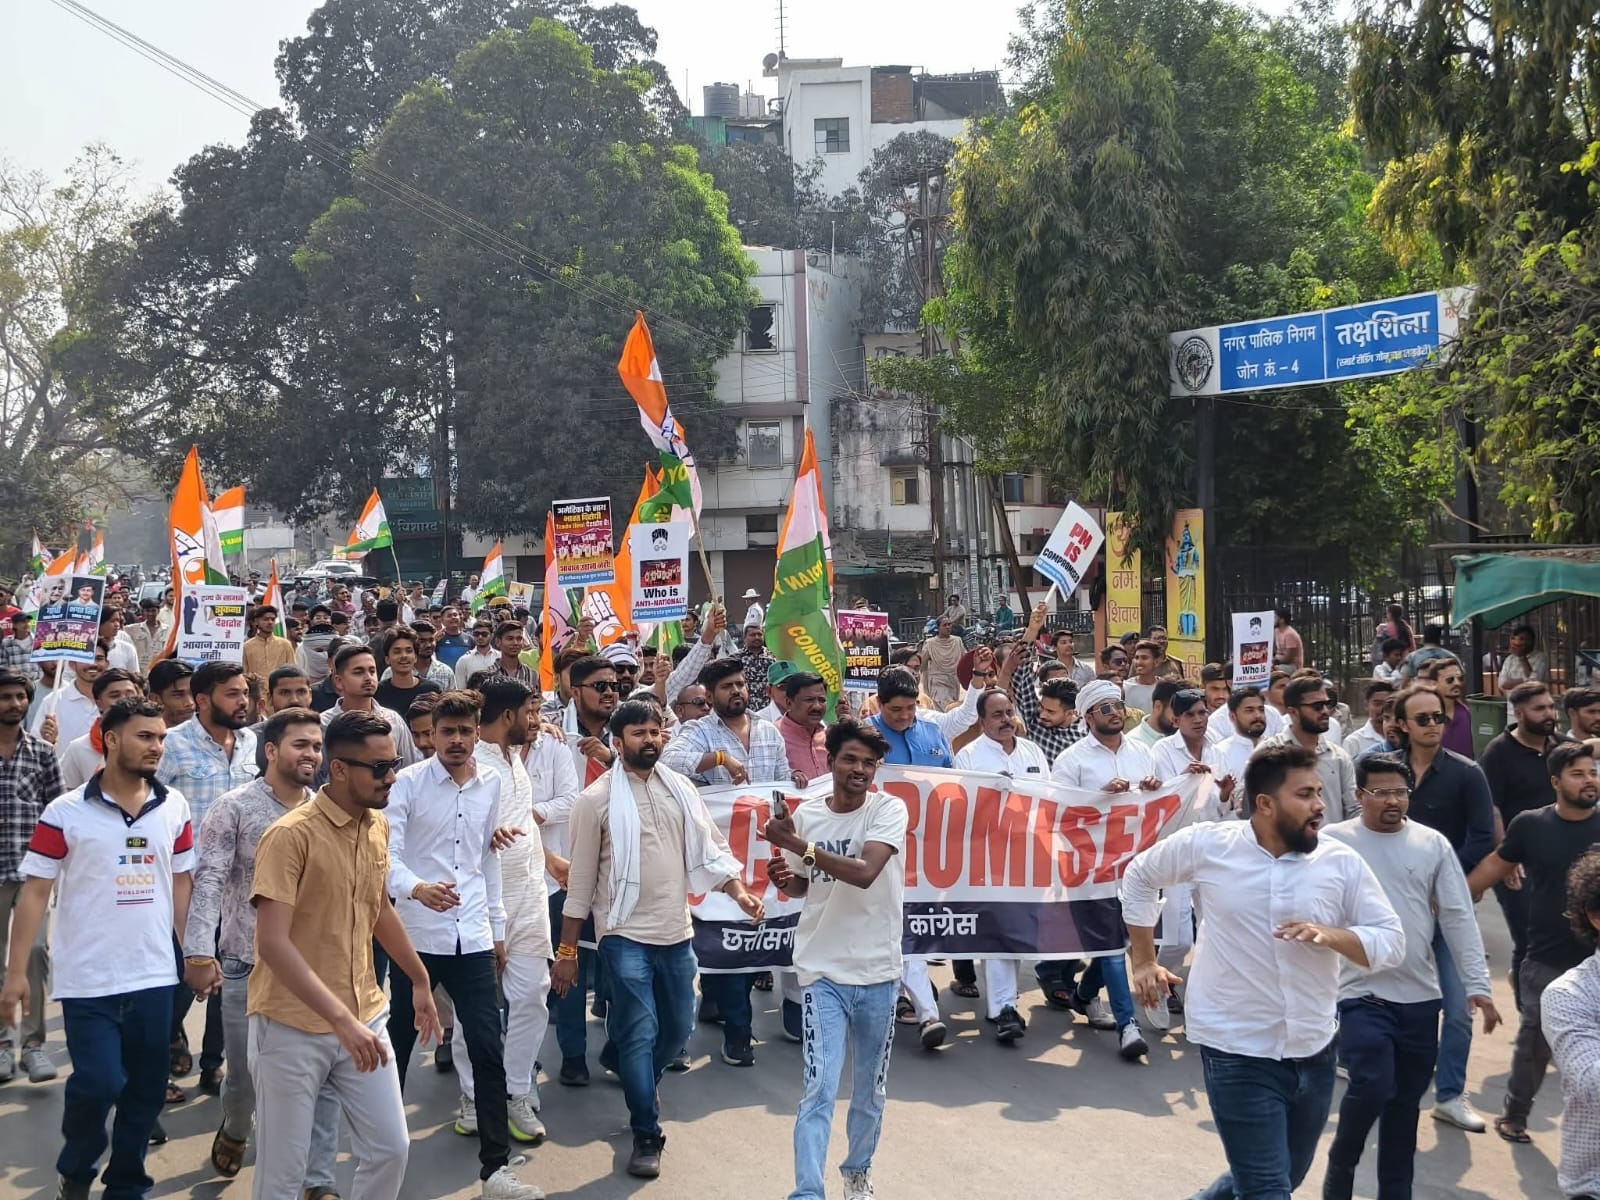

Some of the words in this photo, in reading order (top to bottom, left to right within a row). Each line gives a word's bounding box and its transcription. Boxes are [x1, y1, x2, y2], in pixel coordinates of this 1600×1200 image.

[1223, 336, 1246, 352] नगर
[1248, 328, 1284, 349] पालिक
[1286, 324, 1317, 345] निगम
[1334, 310, 1431, 348] तक्षशिला
[1236, 360, 1259, 379] जोन
[1069, 523, 1093, 550] PM
[1064, 541, 1081, 563] IS
[644, 588, 667, 599] Who
[669, 586, 679, 597] is
[1107, 599, 1140, 624] शिवाय
[183, 641, 213, 650] आवाज
[214, 641, 240, 650] उठाना
[200, 650, 221, 660] नहीं!
[787, 625, 840, 693] CONGRESS
[846, 655, 882, 667] समझा
[1242, 665, 1259, 674] Who
[1260, 664, 1266, 673] is
[116, 873, 155, 887] GUCCI
[721, 923, 797, 952] छत्तीसग
[908, 907, 979, 937] कांग्रेस
[805, 992, 816, 1078] BALMAIN
